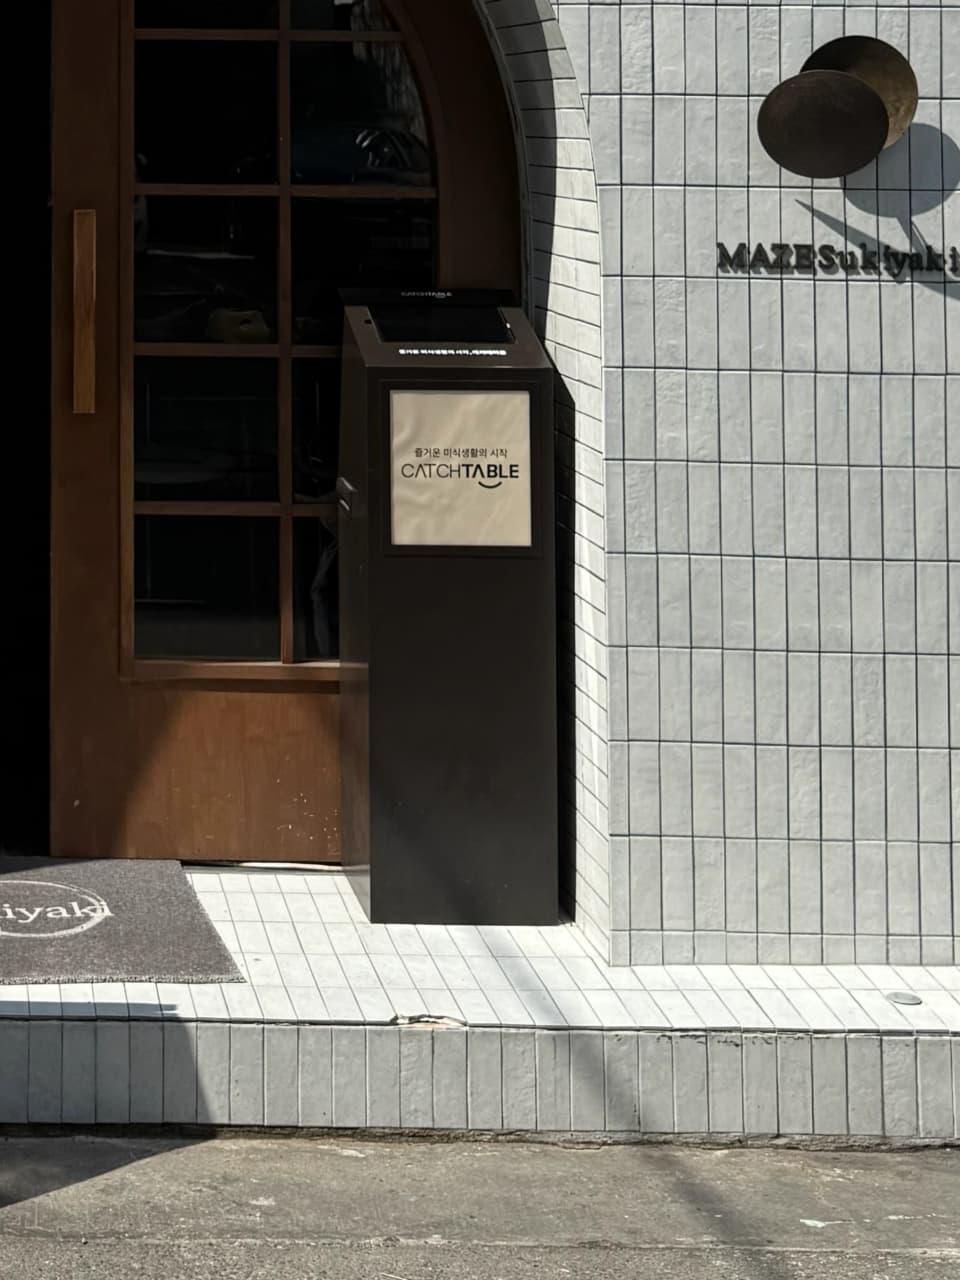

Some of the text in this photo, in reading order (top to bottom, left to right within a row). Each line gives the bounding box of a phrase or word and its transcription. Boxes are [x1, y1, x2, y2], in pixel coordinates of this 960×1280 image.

[414, 448, 440, 458] 즐거운
[490, 448, 508, 458] 시작
[401, 463, 519, 478] CATCHTABLE
